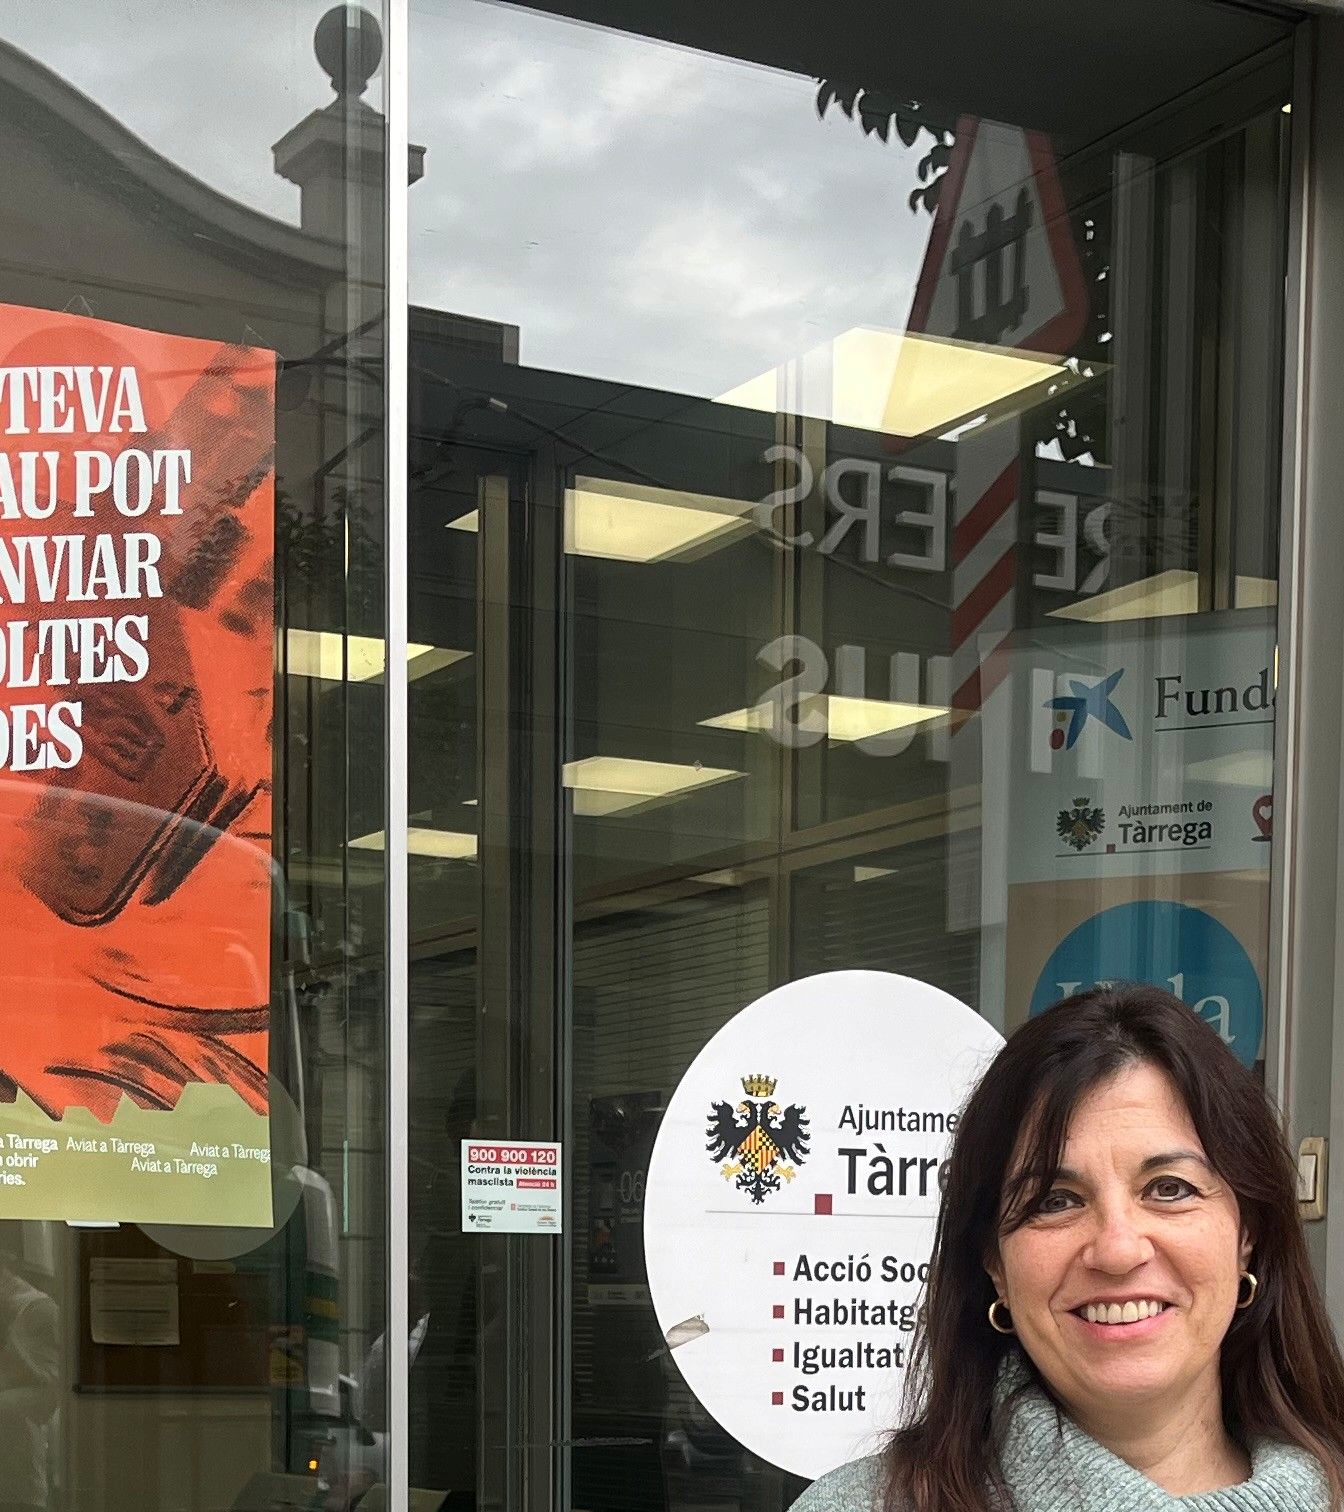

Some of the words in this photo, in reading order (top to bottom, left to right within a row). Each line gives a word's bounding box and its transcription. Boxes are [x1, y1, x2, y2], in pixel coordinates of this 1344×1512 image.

[74, 449, 191, 517] POT
[1156, 668, 1277, 719] Fund
[1119, 800, 1194, 818] Ajuntament
[1197, 799, 1213, 813] de
[1119, 821, 1213, 847] Tàrrega
[838, 1104, 958, 1136] Ajuntame
[6, 1134, 58, 1153] Tàrrega
[66, 1137, 97, 1152] Aviat
[100, 1142, 108, 1152] a
[110, 1138, 155, 1157] Tàrrega
[470, 1149, 496, 1161] 900
[501, 1150, 527, 1162] 900
[531, 1151, 555, 1163] 120
[6, 1153, 38, 1167] obrir
[468, 1165, 500, 1174] Contra
[504, 1166, 512, 1174] la
[515, 1166, 556, 1176] violència
[838, 1143, 949, 1196] Tàrr
[468, 1178, 513, 1186] masclista
[793, 1253, 871, 1282] Acció
[881, 1255, 930, 1283] Soc
[793, 1342, 904, 1374] Igualtat
[792, 1385, 865, 1412] Salut
